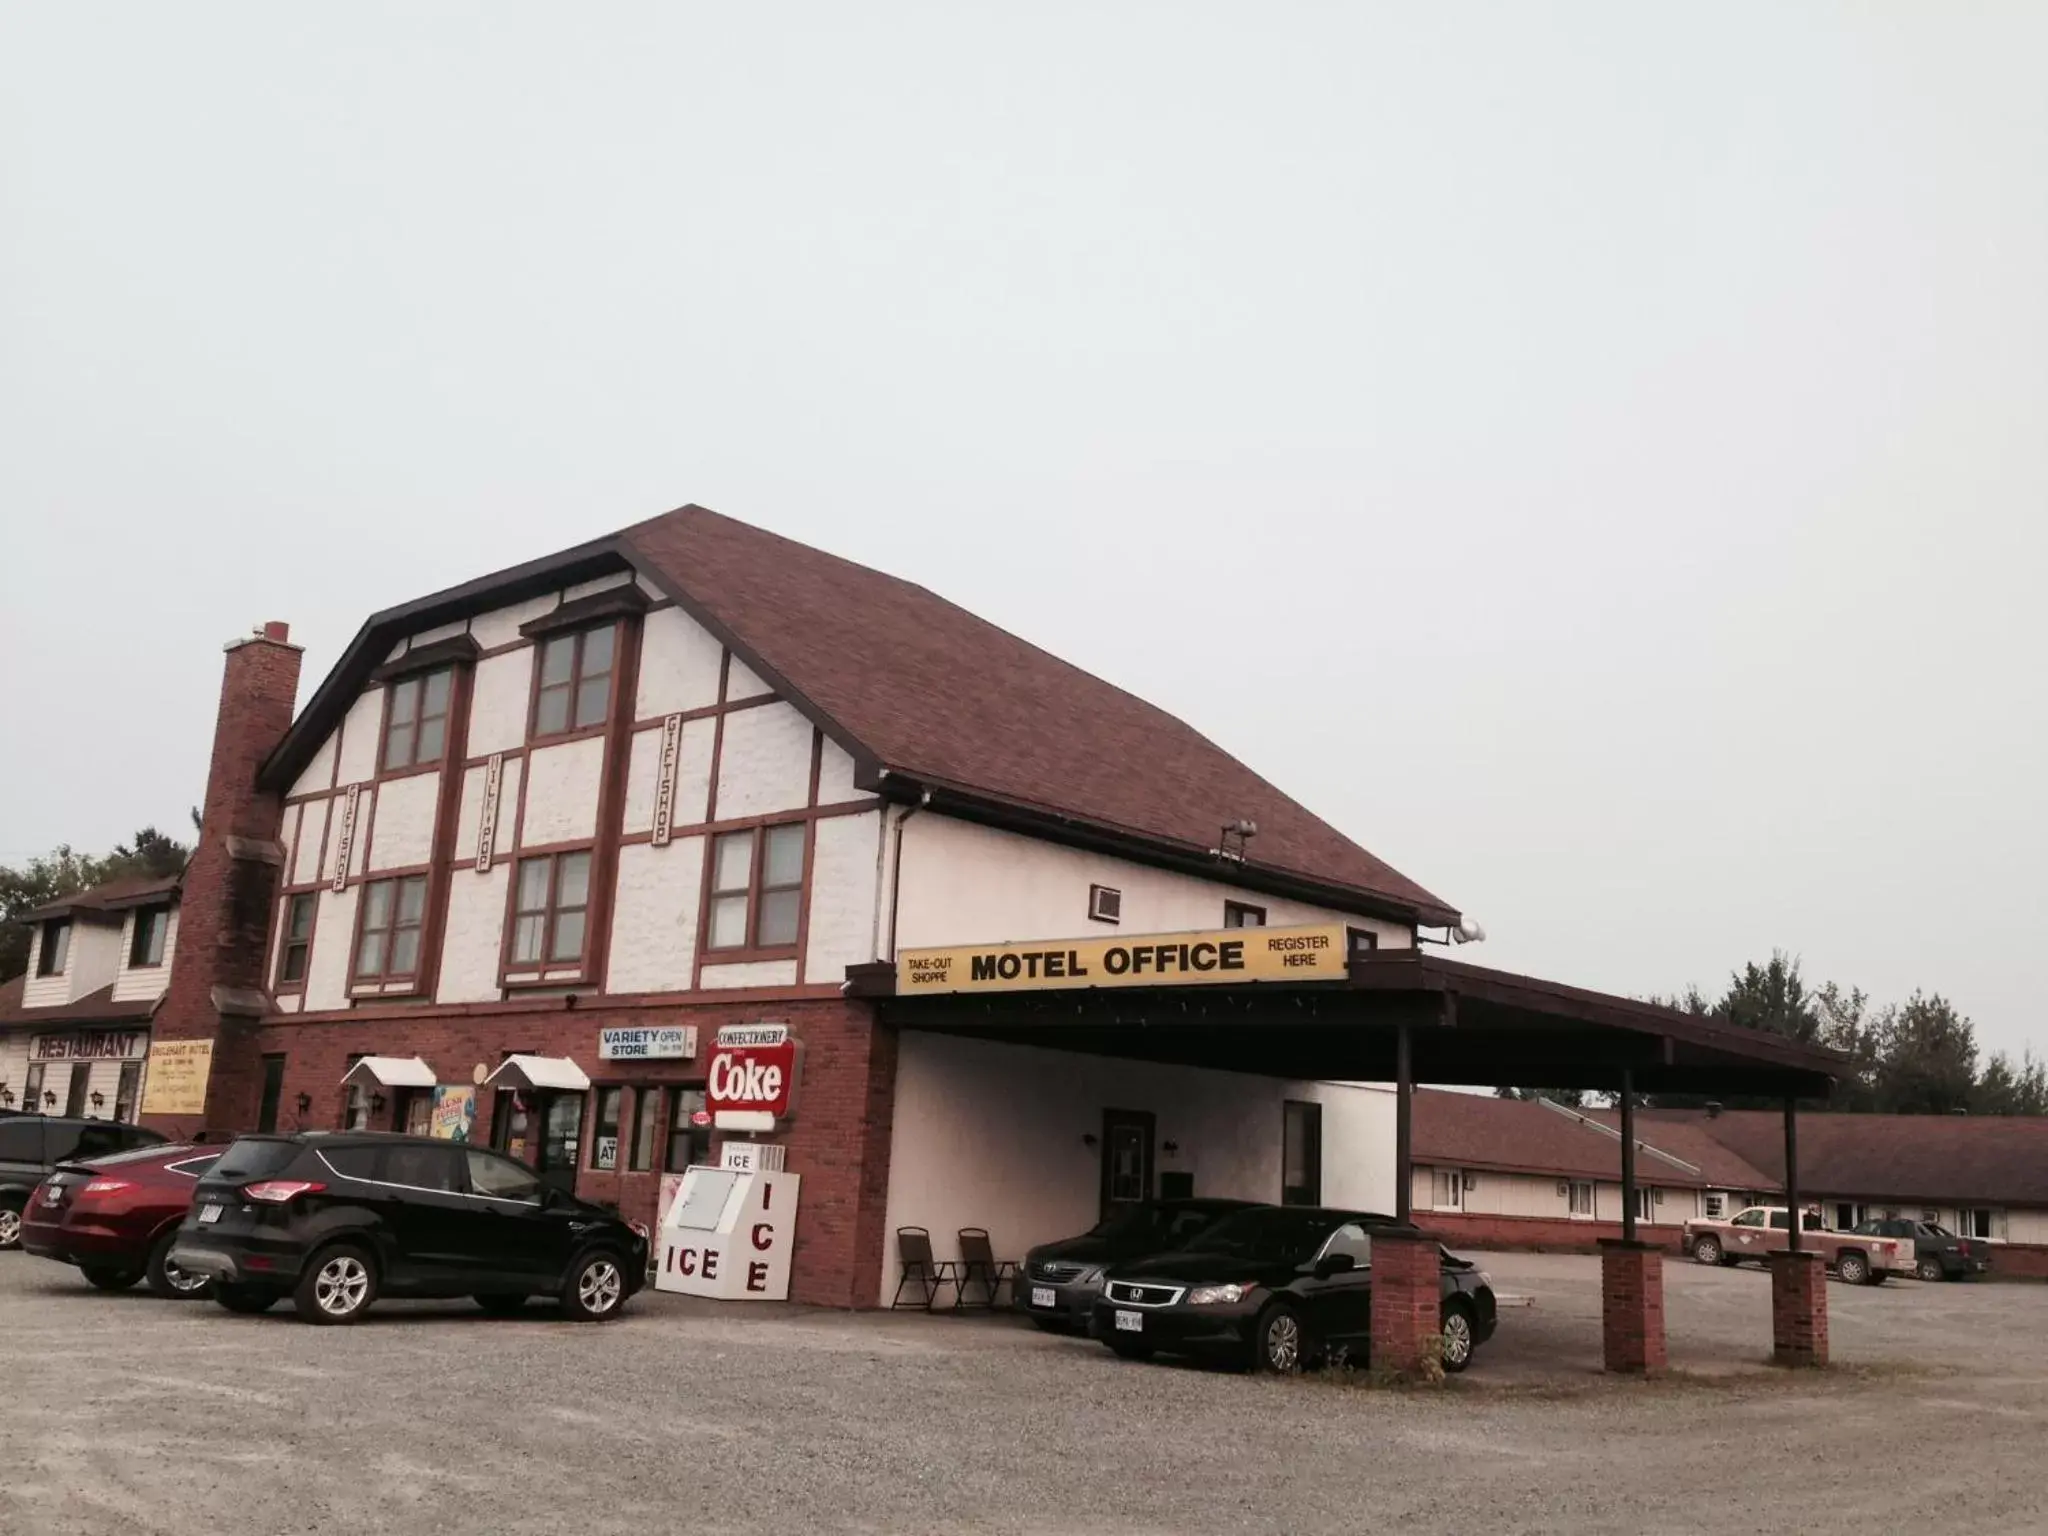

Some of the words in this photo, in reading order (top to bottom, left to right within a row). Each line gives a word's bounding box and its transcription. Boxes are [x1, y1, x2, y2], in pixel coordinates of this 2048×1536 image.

[1268, 936, 1329, 951] REGISTER
[908, 957, 952, 970] TAKE-OUT
[971, 950, 1088, 981] MOTEL
[1103, 941, 1245, 975] OFFICE
[1283, 953, 1317, 967] HERE
[912, 972, 947, 983] SHOPPE
[603, 1030, 660, 1044] VARIETY
[660, 1031, 682, 1042] OPEN
[38, 1033, 137, 1058] RESTAURANT
[611, 1044, 648, 1056] STORE
[710, 1053, 781, 1101] Coke
[728, 1155, 750, 1168] ICE
[747, 1181, 774, 1292] ICE
[666, 1246, 719, 1280] ICE
